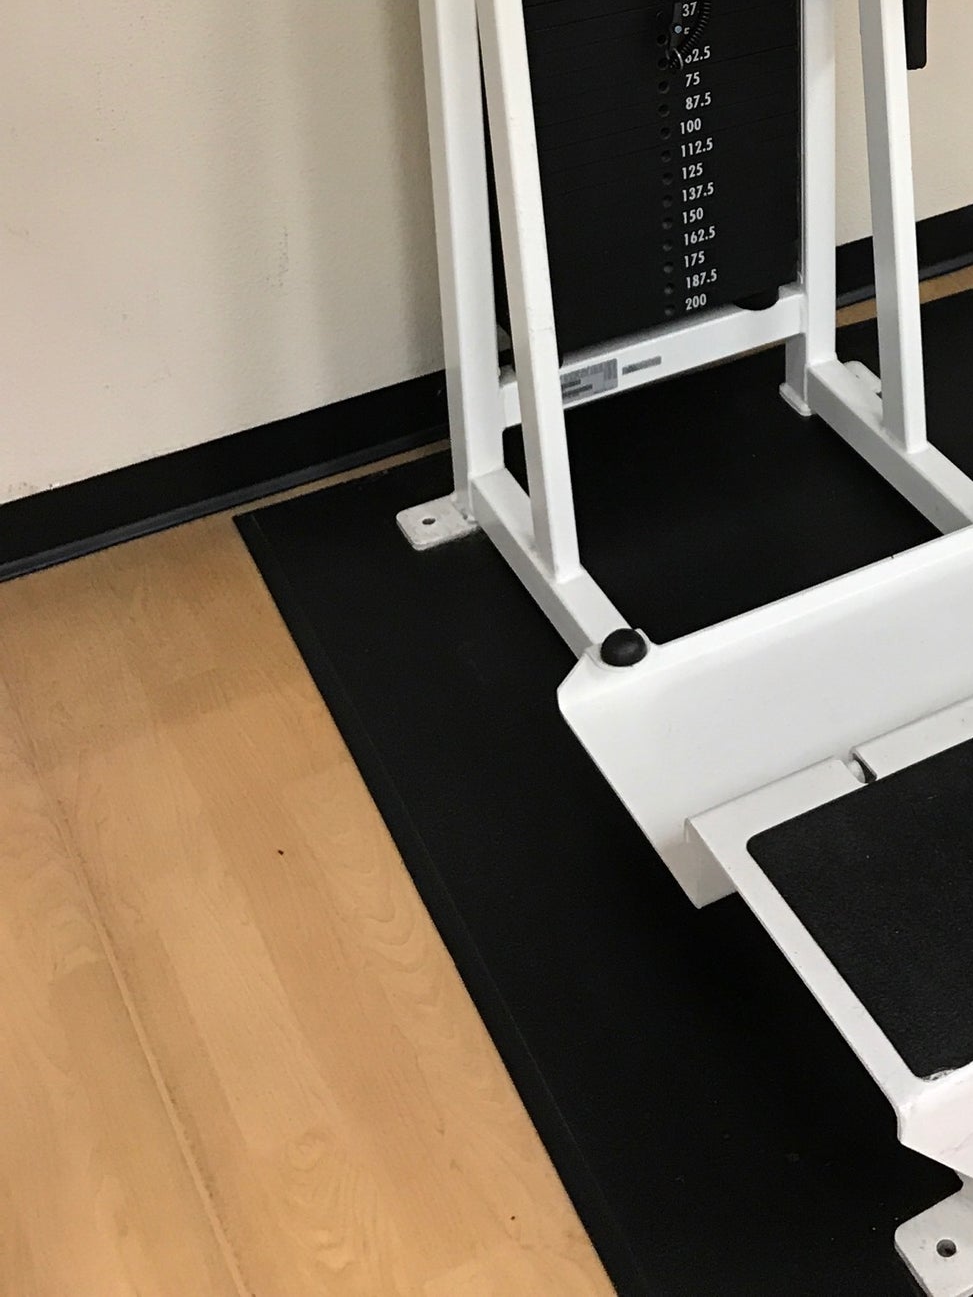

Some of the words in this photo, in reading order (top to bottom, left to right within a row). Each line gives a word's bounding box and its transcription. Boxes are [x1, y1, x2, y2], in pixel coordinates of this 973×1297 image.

[685, 71, 701, 88] 75
[685, 92, 711, 110] 87.5
[680, 118, 702, 135] 100
[680, 137, 713, 158] 112.5
[681, 162, 703, 180] 125
[682, 182, 714, 203] 137.5
[682, 207, 704, 224] 150
[683, 225, 716, 246] 162.5
[684, 250, 705, 268] 175
[685, 268, 717, 289] 187.5
[685, 293, 707, 311] 200
